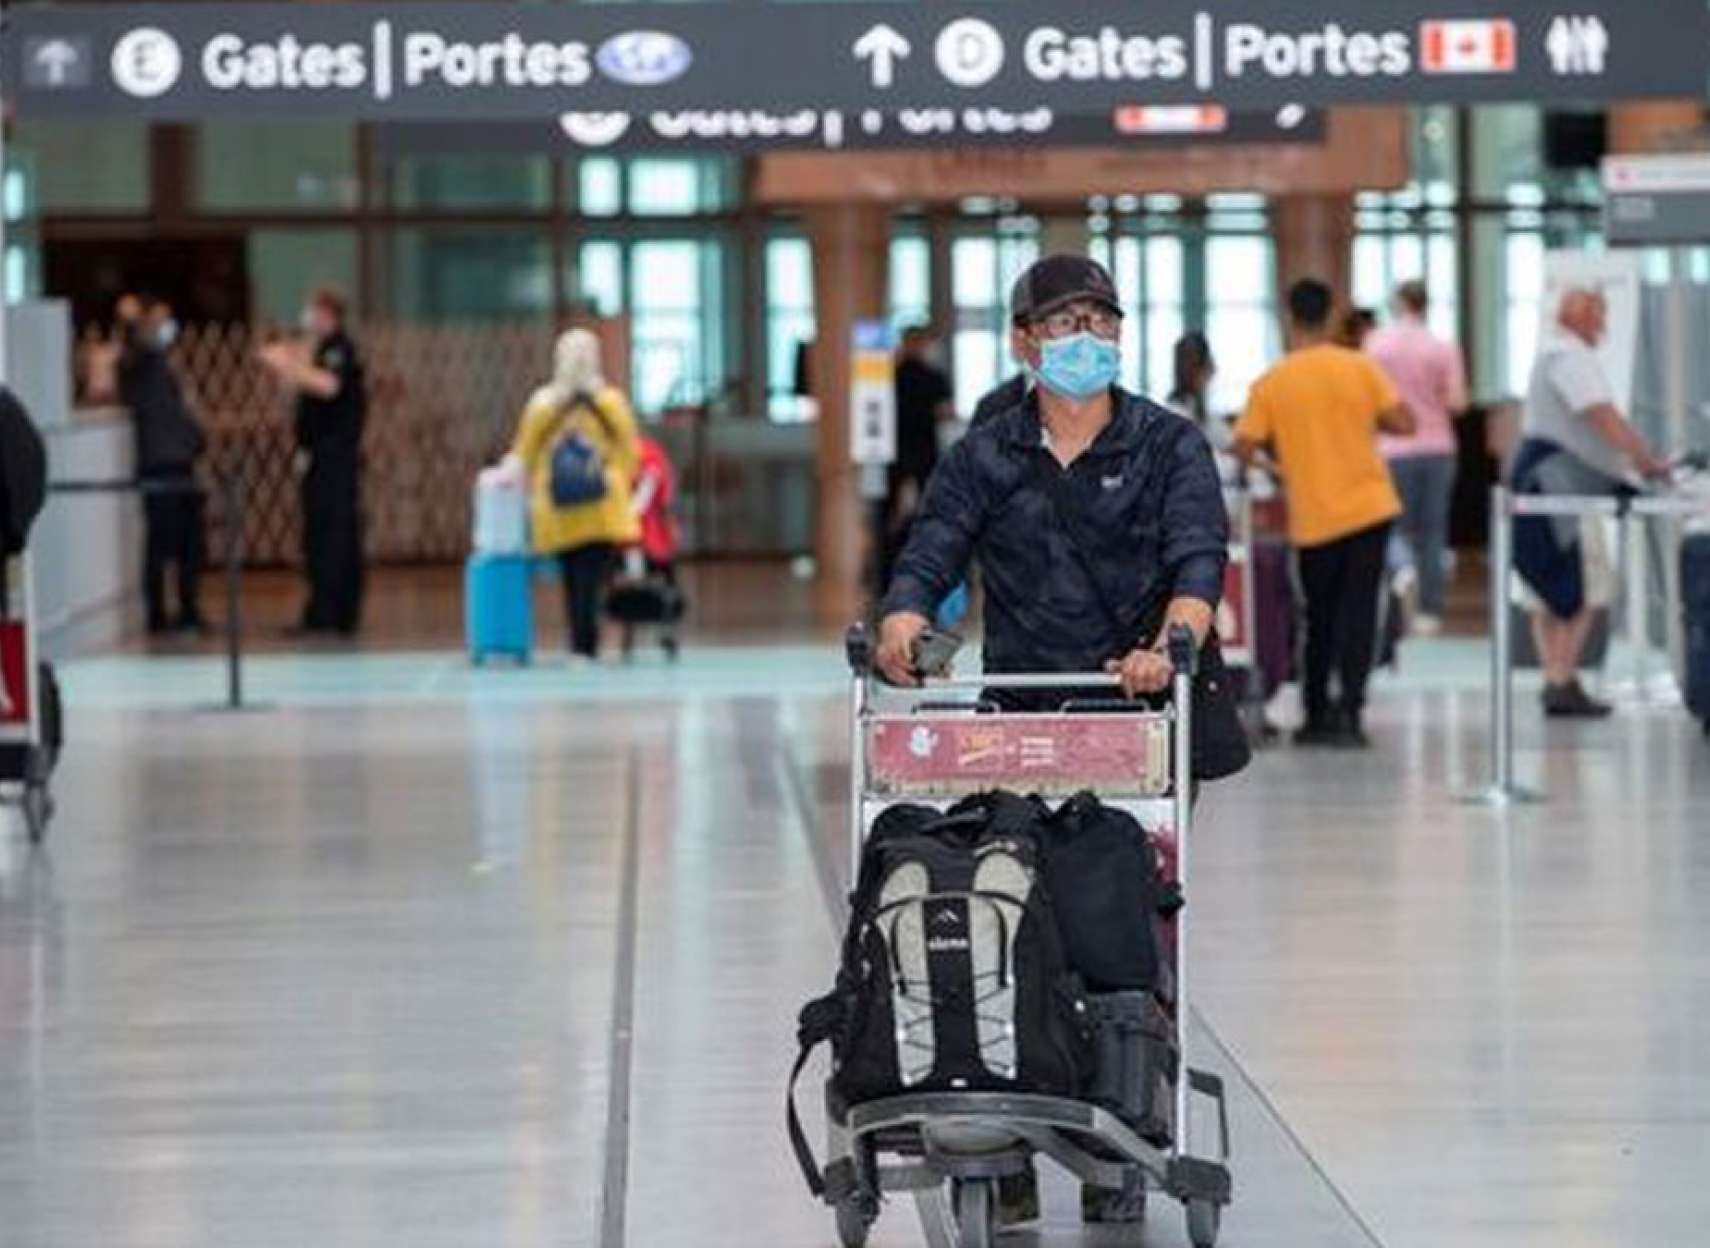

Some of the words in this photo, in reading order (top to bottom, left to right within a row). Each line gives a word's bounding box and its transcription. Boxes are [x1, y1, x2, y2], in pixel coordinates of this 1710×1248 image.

[202, 33, 367, 88] Gates
[404, 32, 592, 87] Portes
[1023, 26, 1187, 81] Gates
[1225, 23, 1411, 78] Portes
